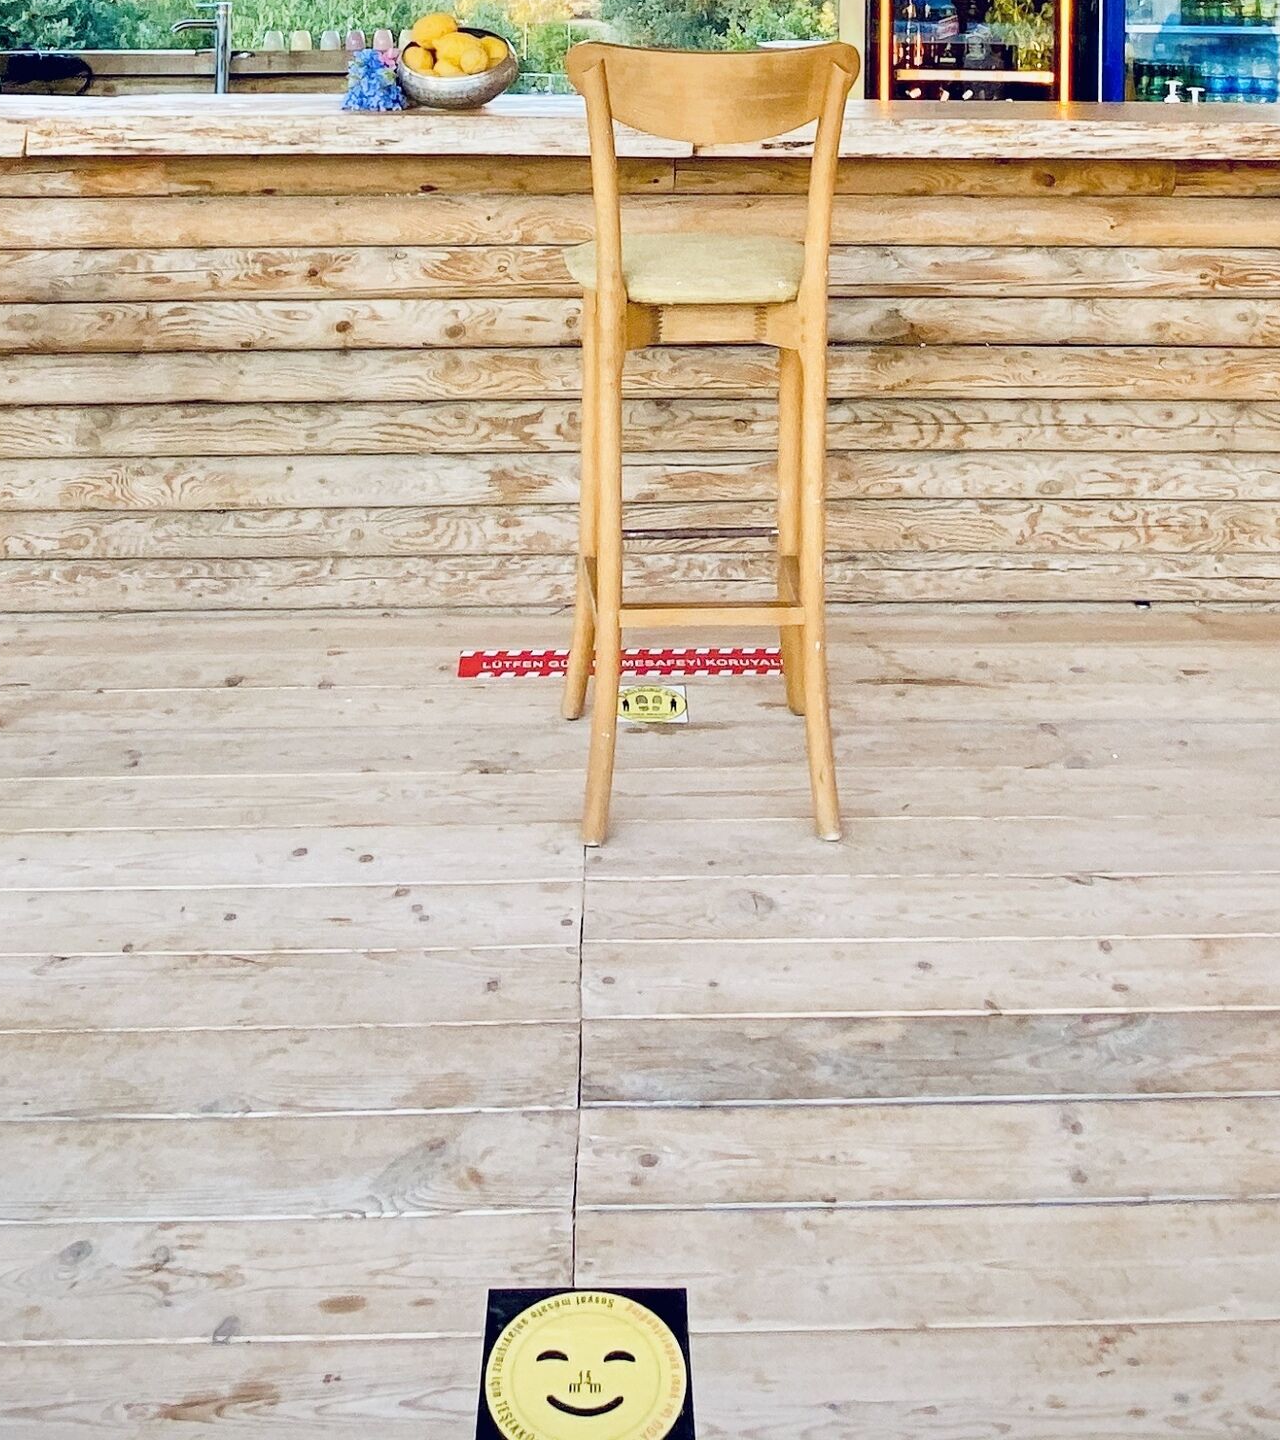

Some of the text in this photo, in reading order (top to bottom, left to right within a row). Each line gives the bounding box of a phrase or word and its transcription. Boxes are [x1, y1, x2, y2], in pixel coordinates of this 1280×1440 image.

[481, 659, 542, 669] LÜTFEN
[621, 657, 700, 667] MESAFEYİ
[705, 657, 784, 667] KORUYALI
